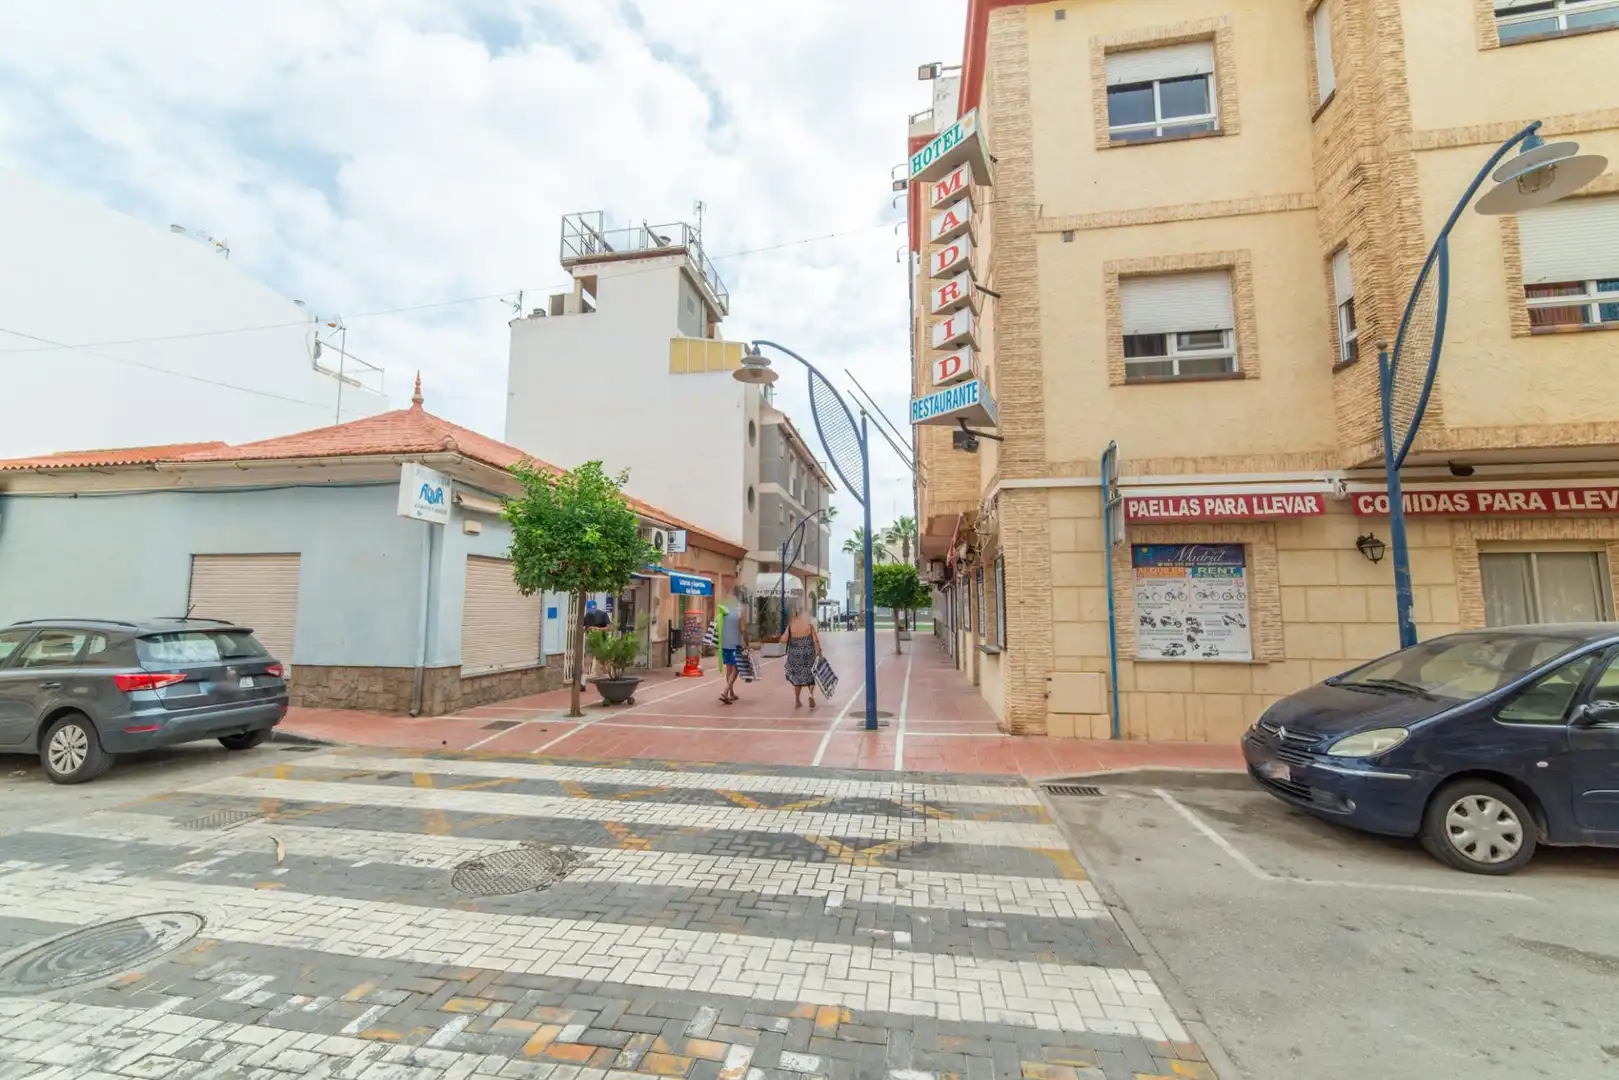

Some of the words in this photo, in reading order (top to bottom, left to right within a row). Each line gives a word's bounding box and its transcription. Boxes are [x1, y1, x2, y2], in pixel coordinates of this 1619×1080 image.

[912, 123, 964, 176] HOTEL
[934, 168, 965, 381] MADRID
[912, 381, 978, 420] RESTAURANTE
[1128, 498, 1201, 518] PAELLAS
[1204, 496, 1249, 516] PARA
[1252, 495, 1320, 515] LLEVAR
[1477, 491, 1547, 511] PARA
[1167, 544, 1227, 562] Madrid
[1197, 566, 1236, 574] RENT
